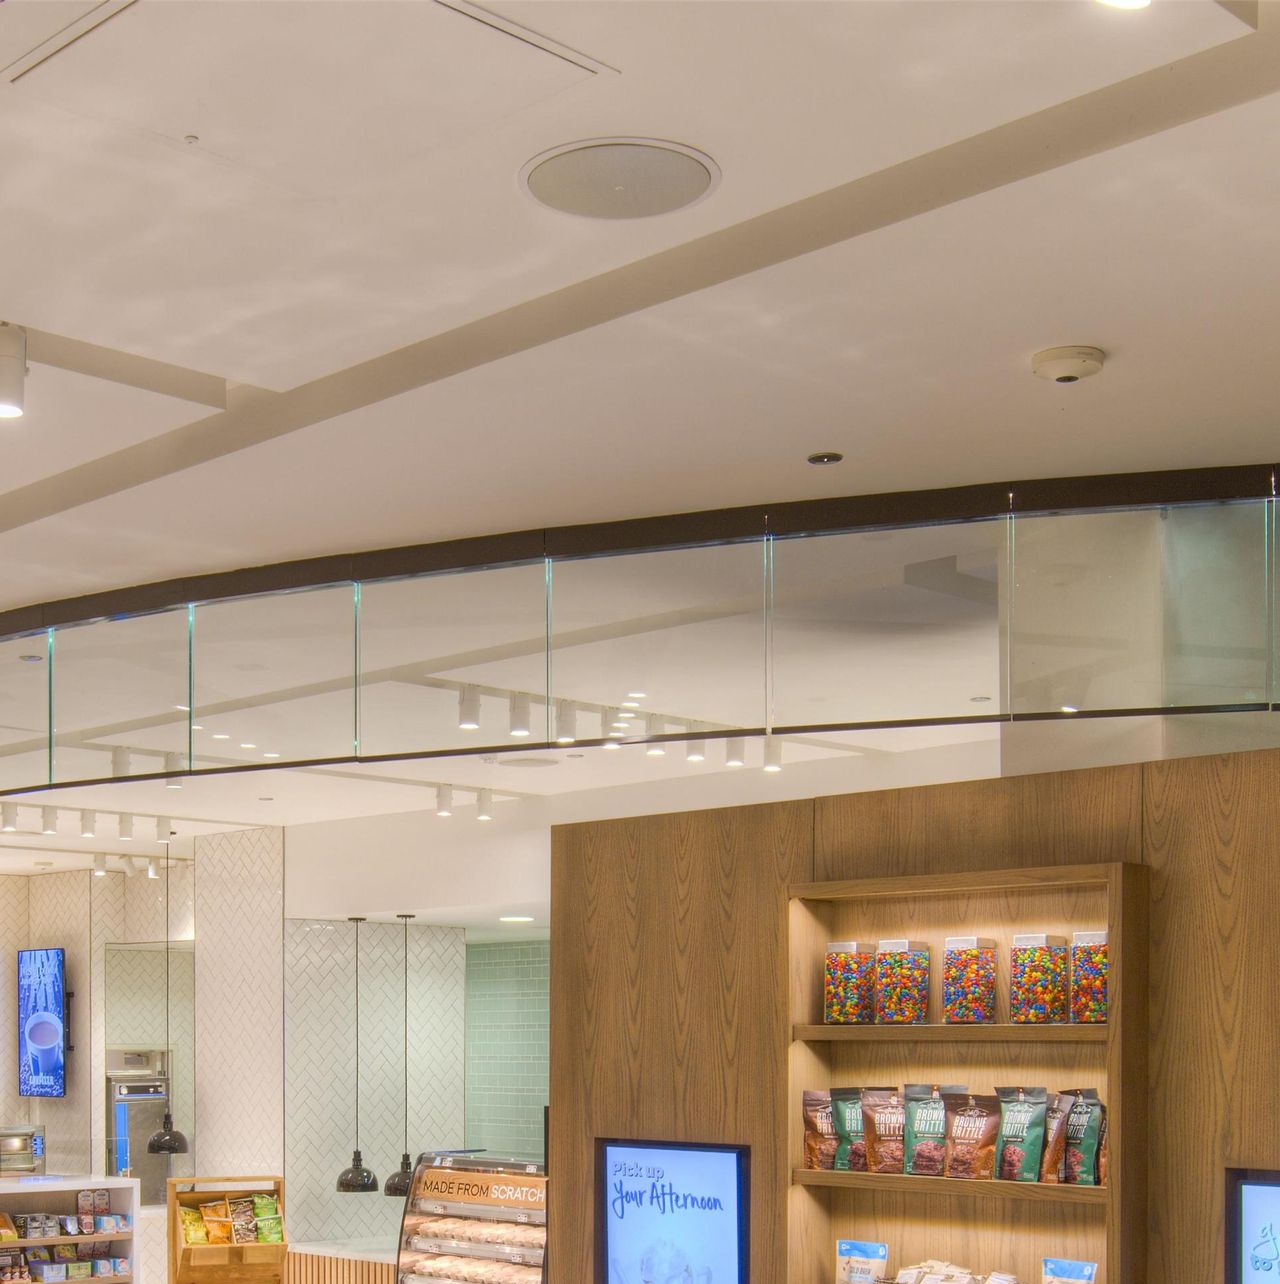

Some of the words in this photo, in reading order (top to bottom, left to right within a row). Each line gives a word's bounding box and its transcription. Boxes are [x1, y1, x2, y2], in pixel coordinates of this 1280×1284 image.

[915, 1109, 945, 1120] BROWN
[914, 1120, 944, 1132] BRITTL
[954, 1115, 988, 1128] BROWNIE
[875, 1124, 904, 1135] BRITTL
[952, 1126, 985, 1139] BRITTLE
[612, 1160, 642, 1177] Pick
[645, 1167, 665, 1182] up
[423, 1180, 454, 1194] MADE
[456, 1183, 489, 1197] FROM
[491, 1185, 545, 1202] SCRATCH
[612, 1179, 646, 1219] Your
[649, 1182, 723, 1214] Afternoon
[1250, 1254, 1272, 1272] to
